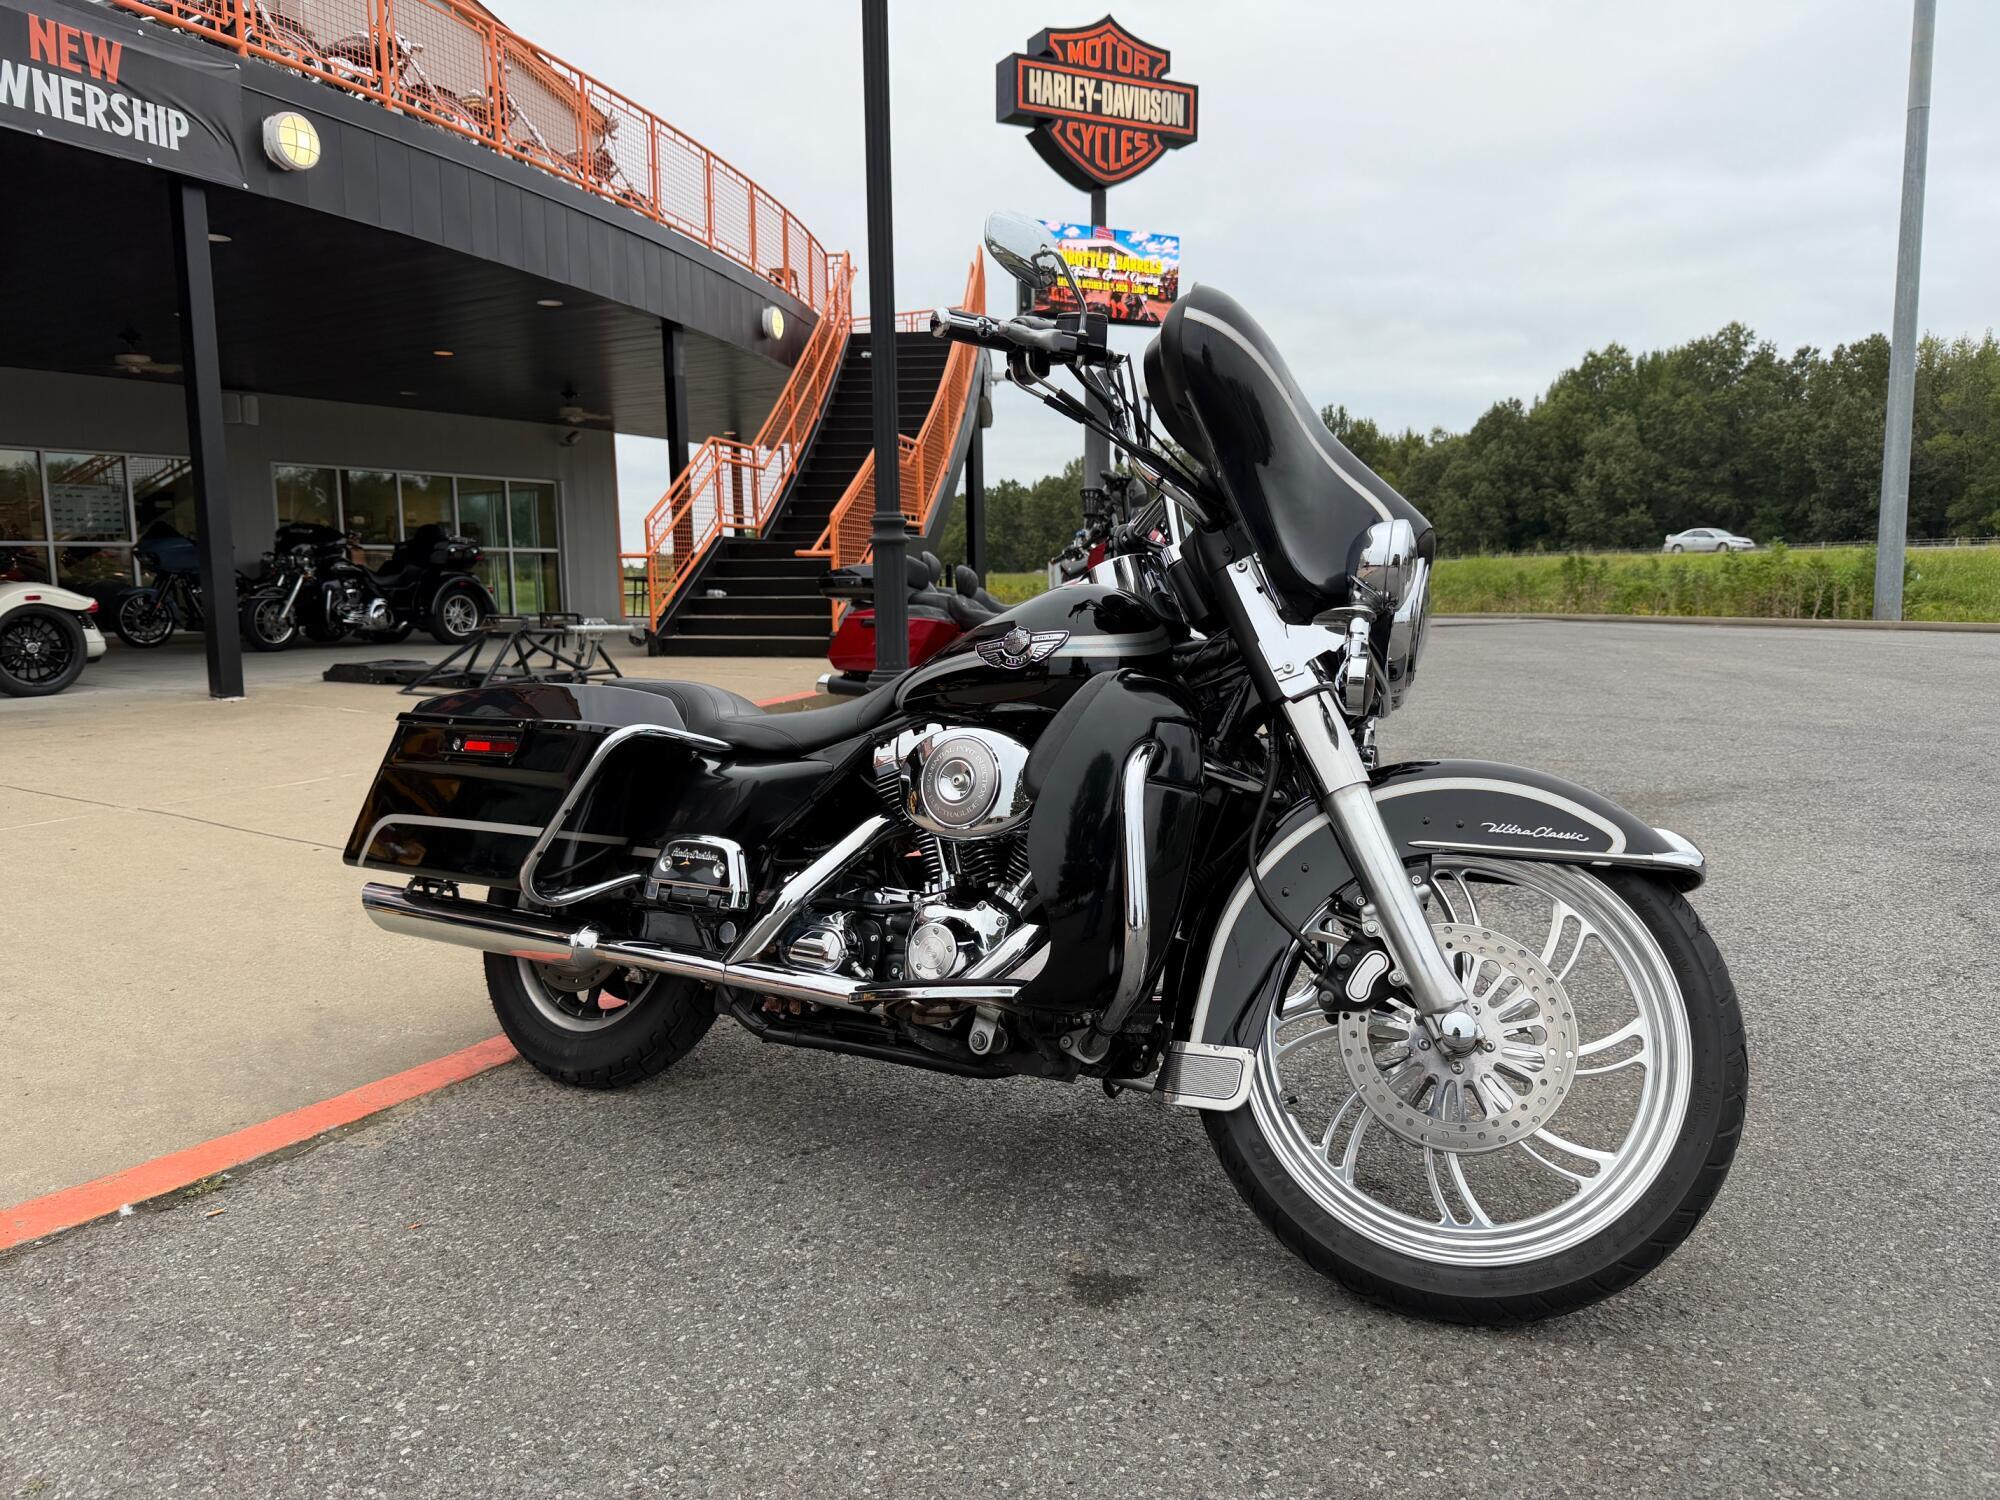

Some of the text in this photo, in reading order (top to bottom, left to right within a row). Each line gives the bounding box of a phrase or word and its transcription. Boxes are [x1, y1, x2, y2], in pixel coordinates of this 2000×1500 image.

[28, 13, 122, 85] NEW
[1067, 32, 1150, 78] MOTOR
[0, 59, 190, 151] WNERSHIP
[1028, 68, 1185, 127] HARLEY-DAVIDSON
[1066, 121, 1151, 172] CYCLES
[1116, 254, 1163, 274] BARRELS
